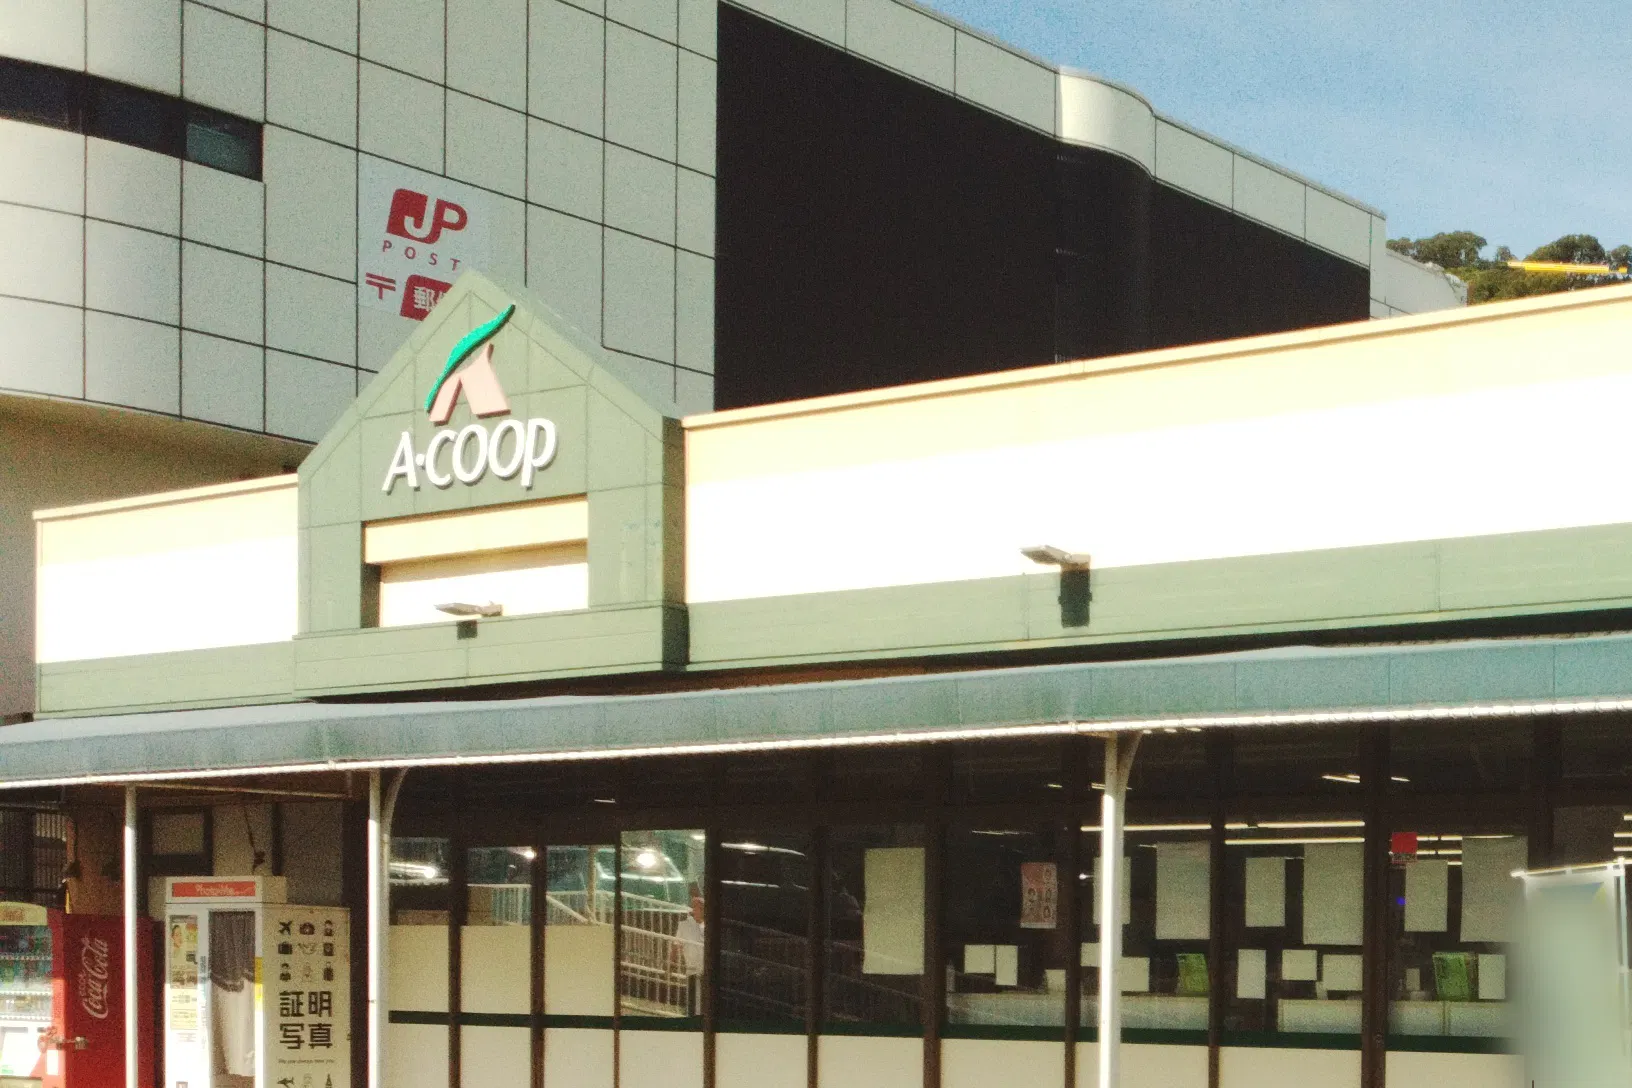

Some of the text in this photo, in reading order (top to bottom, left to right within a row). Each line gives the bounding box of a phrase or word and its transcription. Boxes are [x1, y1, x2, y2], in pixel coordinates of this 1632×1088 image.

[387, 188, 468, 244] JP
[382, 240, 461, 272] POST
[279, 990, 332, 1017] 証明
[279, 1023, 333, 1049] 写真
